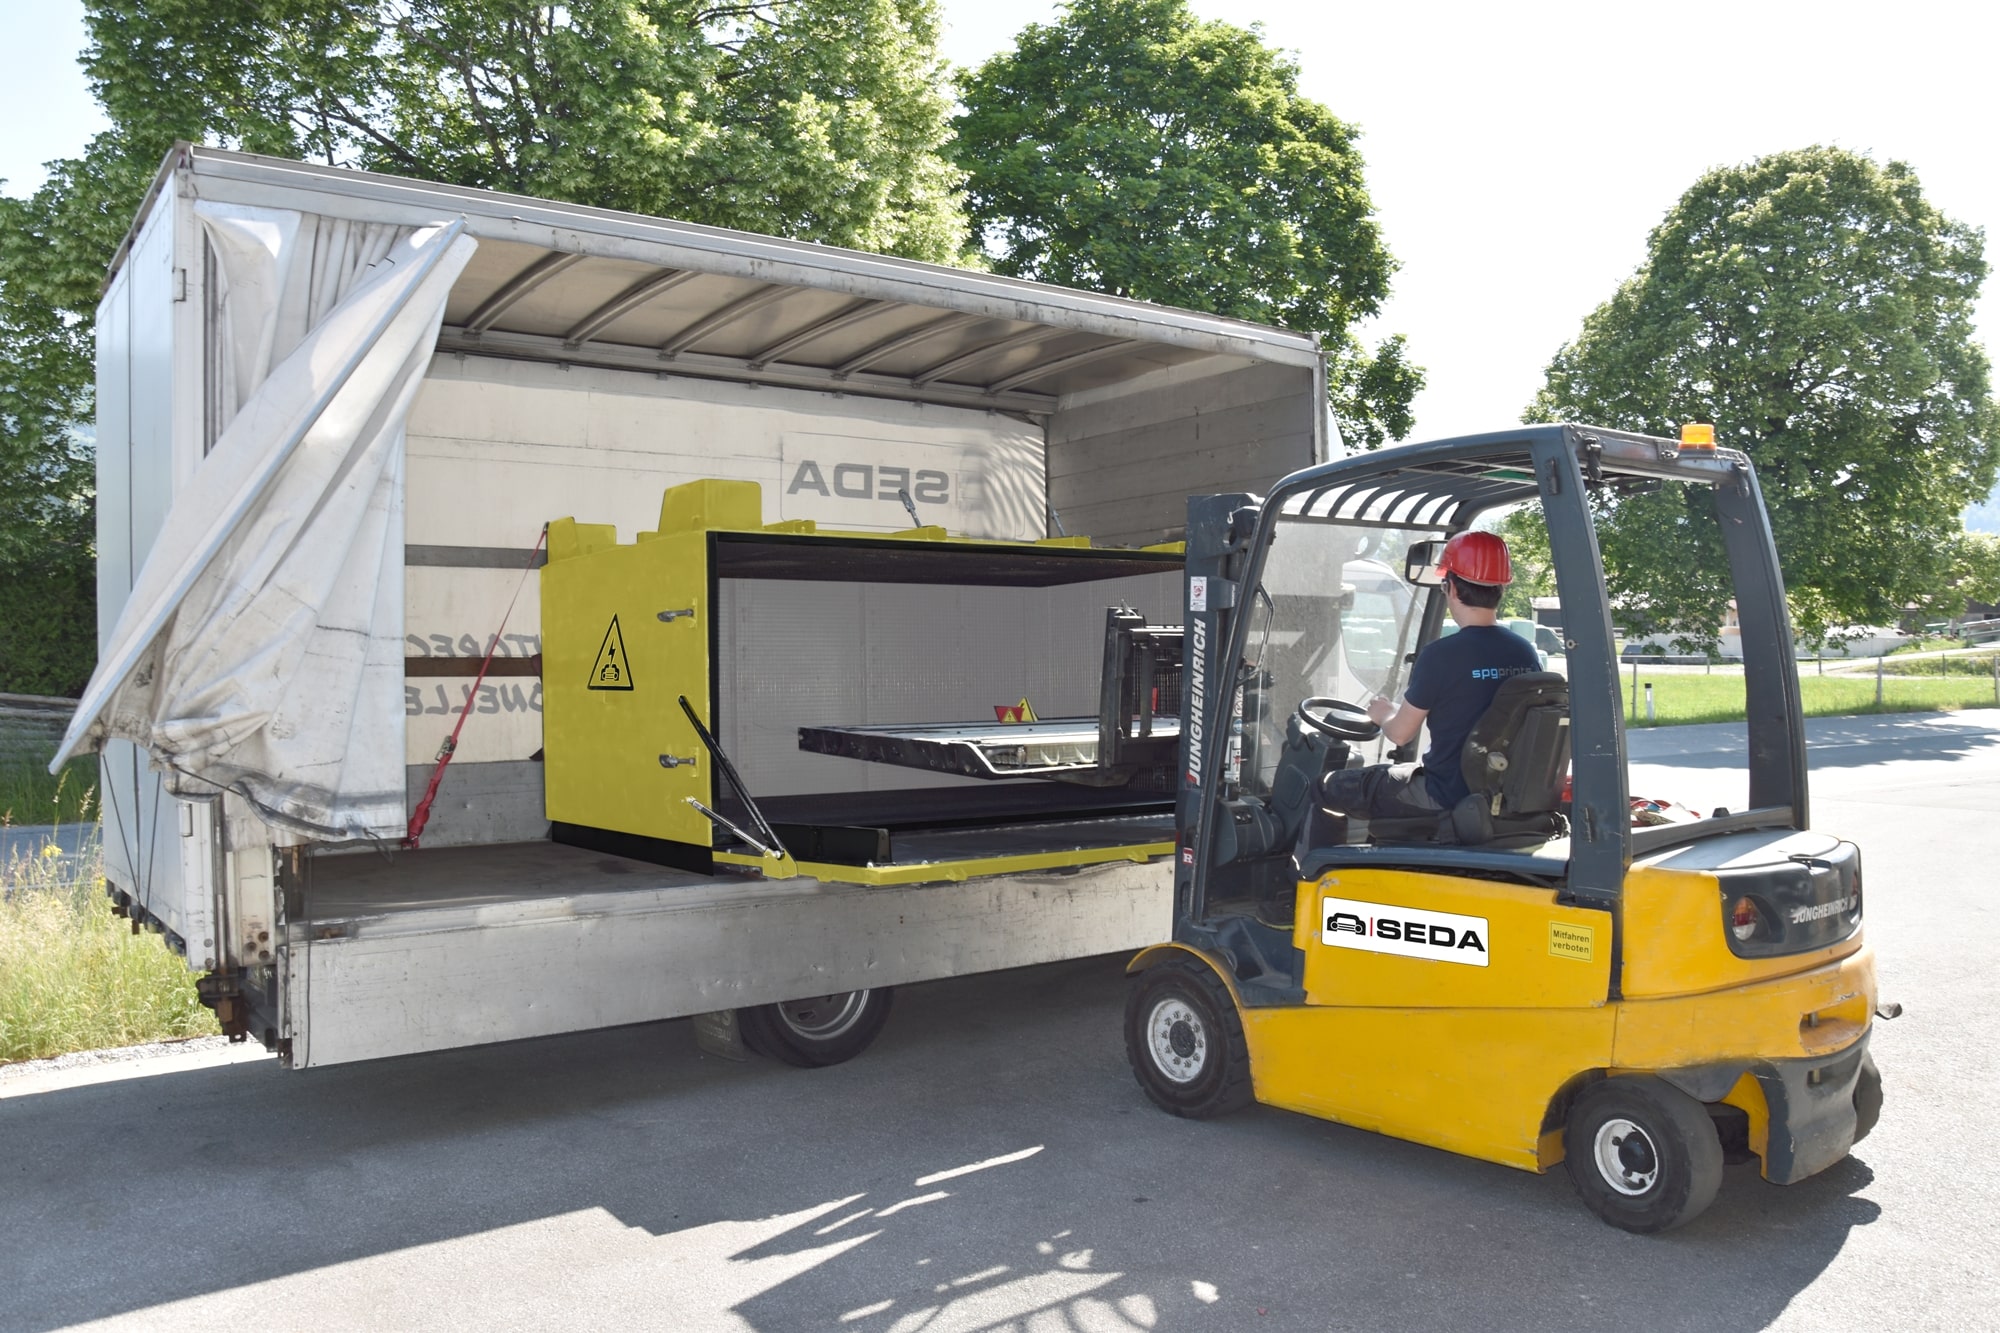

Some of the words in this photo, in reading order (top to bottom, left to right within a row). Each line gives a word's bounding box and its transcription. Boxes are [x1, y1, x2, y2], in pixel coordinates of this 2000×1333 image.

[1186, 618, 1206, 786] JUNGHEINRICH
[1791, 897, 1848, 924] JUNGHEINRICH
[1376, 918, 1486, 952] SEDA
[1552, 929, 1590, 943] Mitfahren
[1552, 941, 1590, 954] verboten
